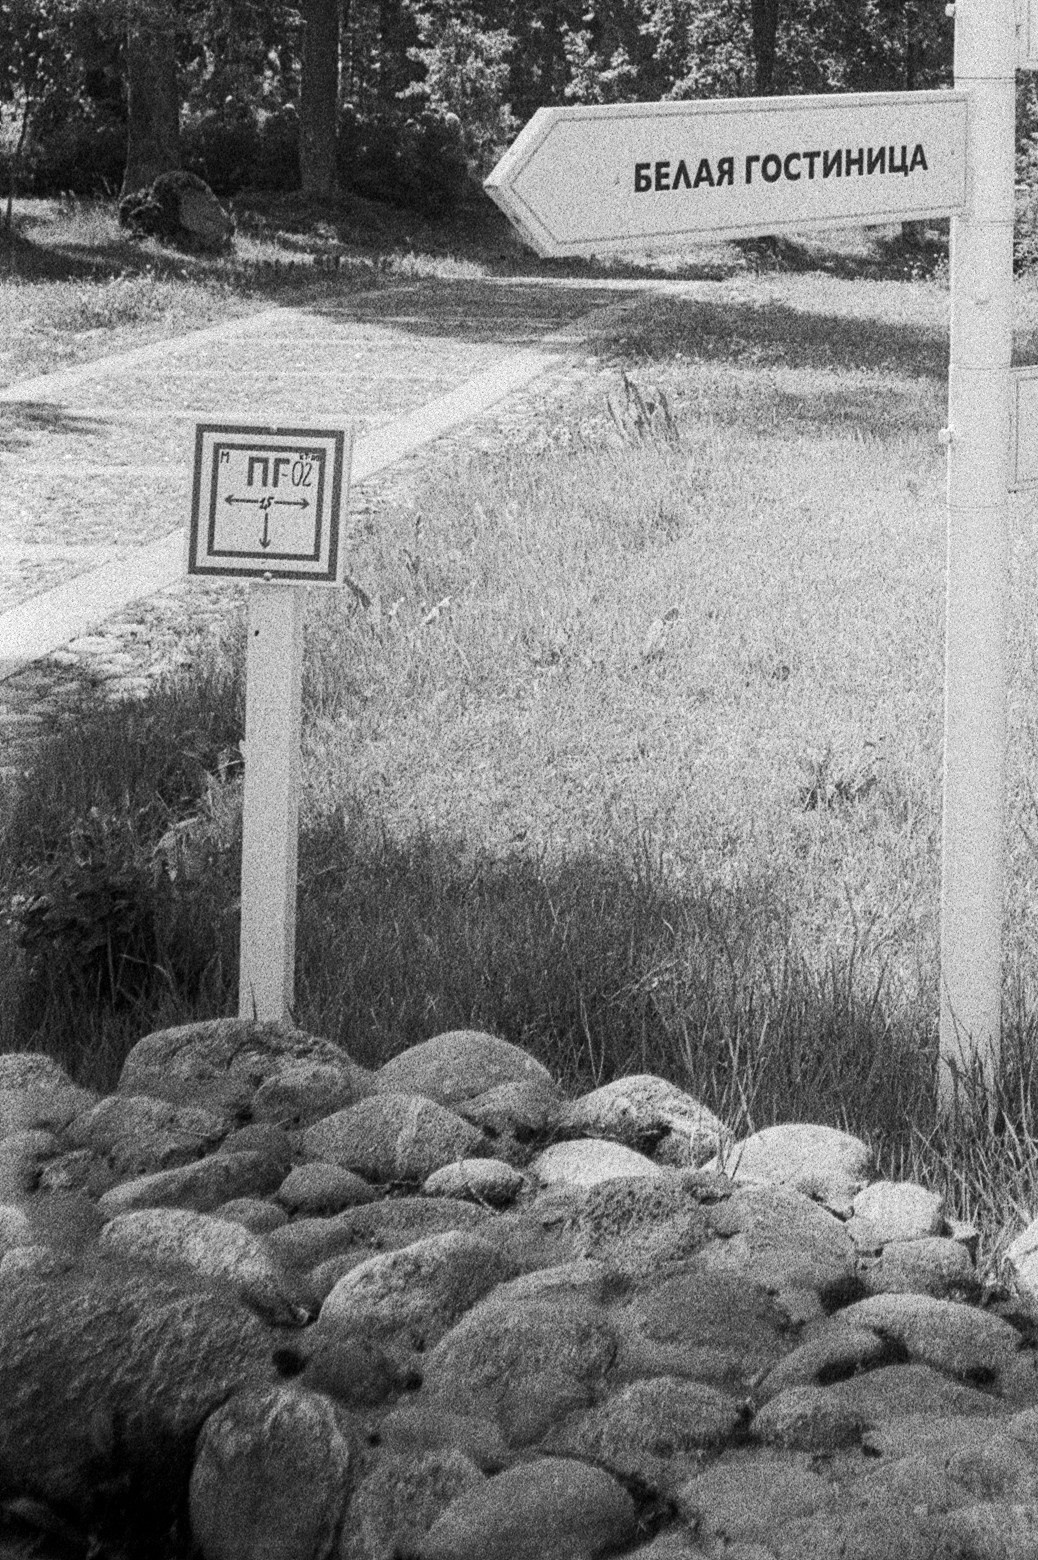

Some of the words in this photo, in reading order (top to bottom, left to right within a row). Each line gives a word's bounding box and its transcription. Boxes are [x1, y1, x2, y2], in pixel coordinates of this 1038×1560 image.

[632, 155, 736, 194] БЕЛАЯ
[744, 142, 930, 187] ГОСТИНИЦА
[246, 455, 313, 488] ПГ-02
